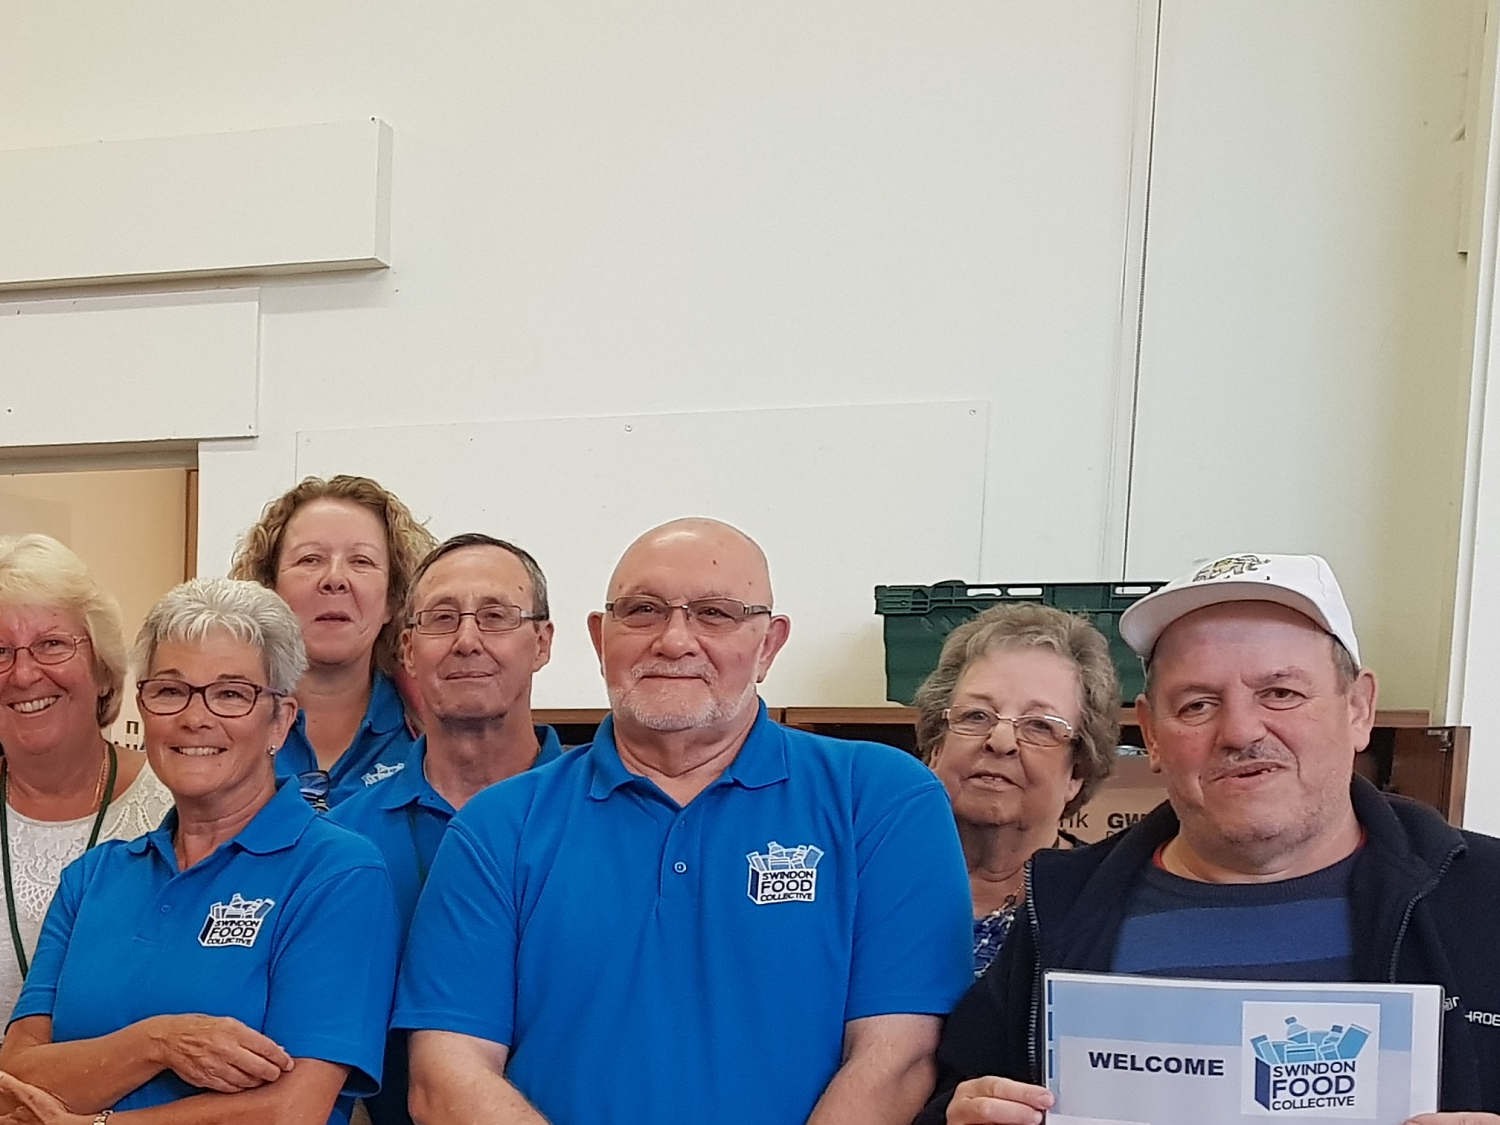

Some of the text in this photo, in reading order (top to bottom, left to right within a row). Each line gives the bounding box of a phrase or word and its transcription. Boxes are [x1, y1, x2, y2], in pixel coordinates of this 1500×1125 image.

[762, 870, 814, 880] SWINDON
[761, 879, 813, 894] FOOD
[760, 892, 813, 902] COLLECTIVE
[214, 919, 260, 927] SWINDON
[209, 926, 256, 938] FOOD
[206, 937, 253, 946] COLLECTIVE
[1088, 1051, 1225, 1076] WELCOME
[1273, 1060, 1356, 1078] SWINDON
[1272, 1075, 1355, 1099] FOOD
[1272, 1096, 1355, 1111] COLLECTIVE
